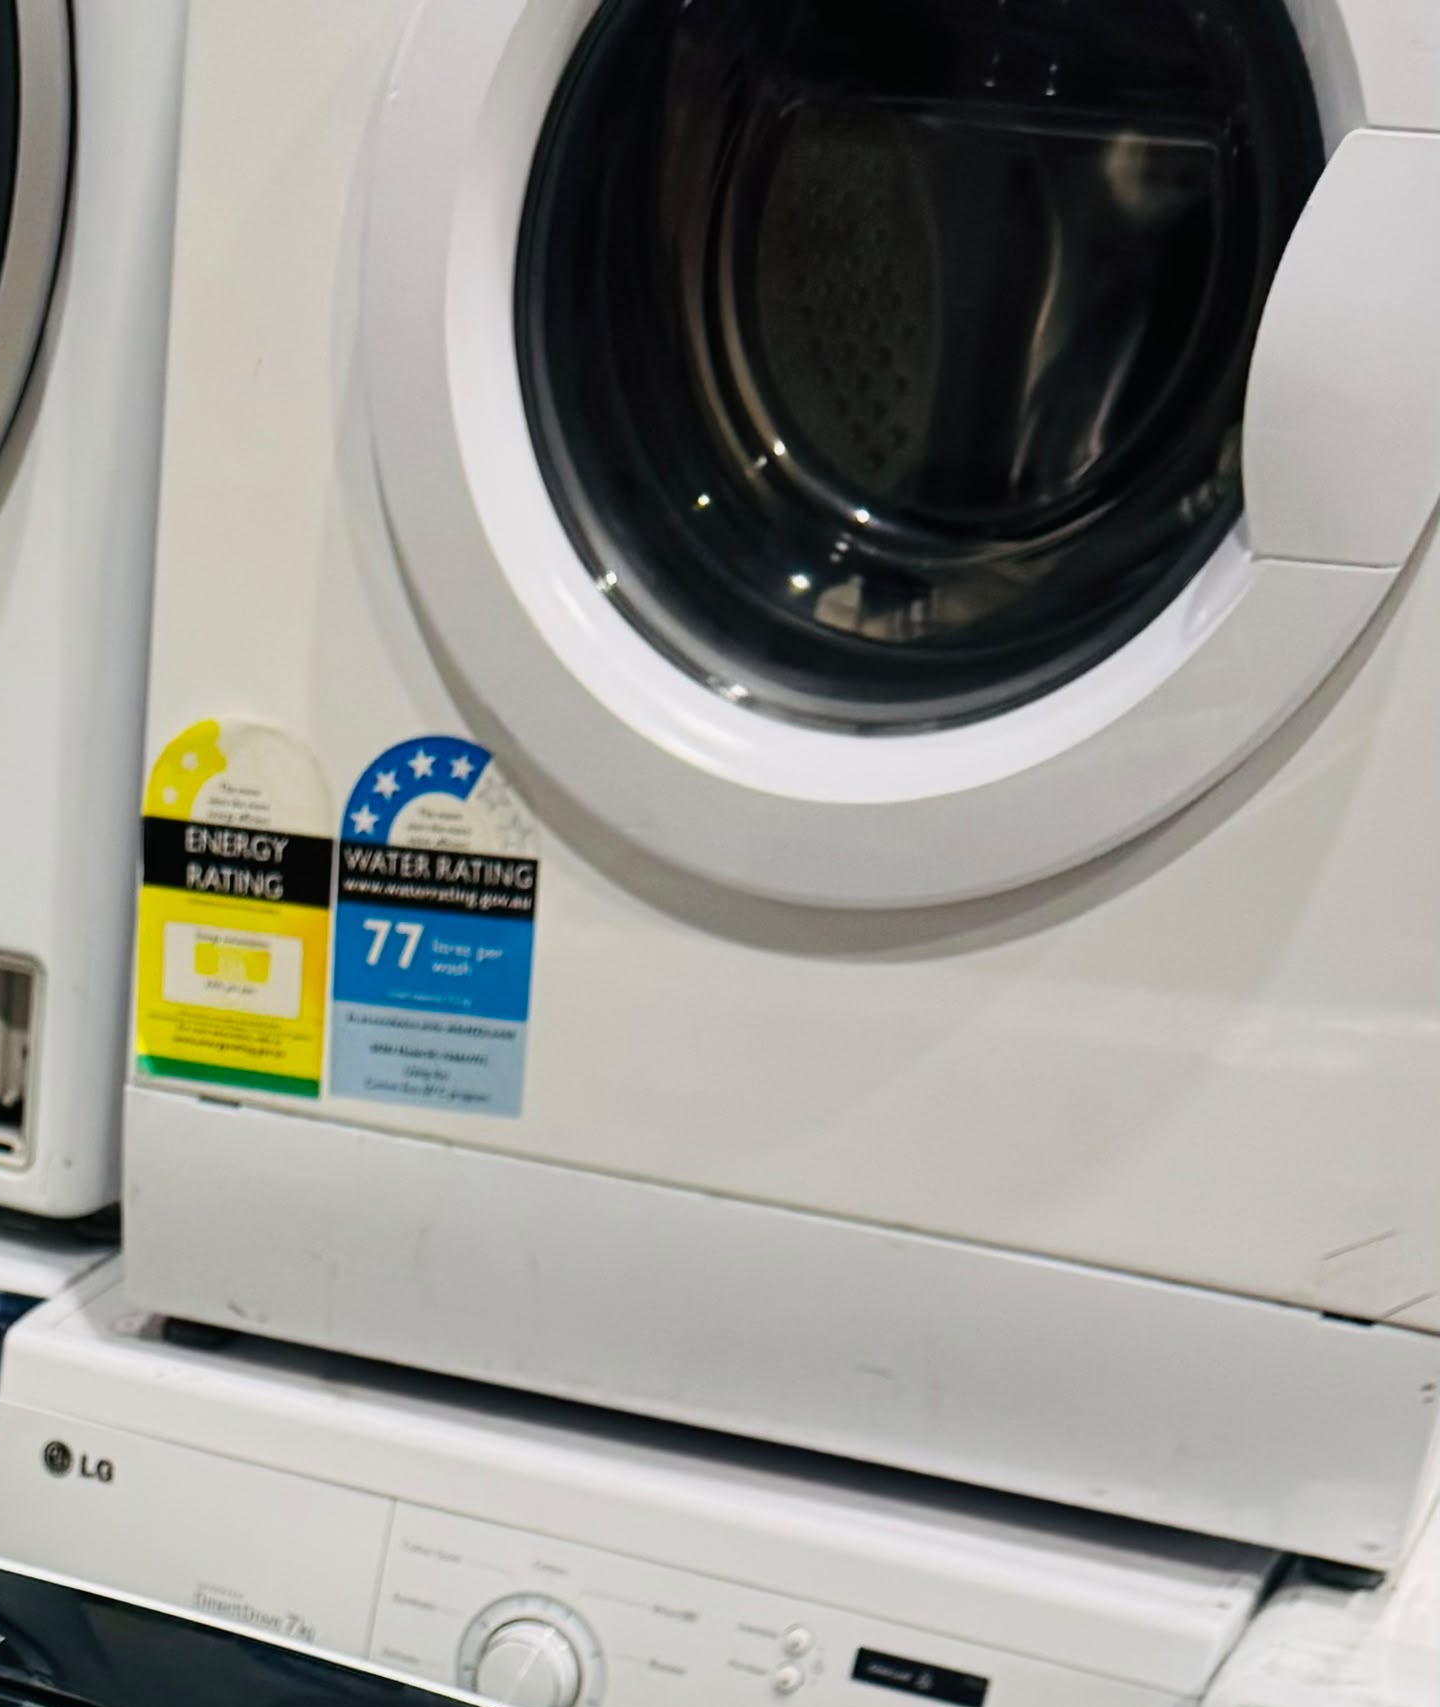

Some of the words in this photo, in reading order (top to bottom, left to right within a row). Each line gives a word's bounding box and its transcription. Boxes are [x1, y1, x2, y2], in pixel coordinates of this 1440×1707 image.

[185, 826, 289, 864] ENERGY
[186, 862, 283, 900] RATING
[344, 846, 430, 879] WATER
[435, 855, 534, 889] RATING
[363, 917, 425, 970] 77
[81, 1454, 113, 1483] LG
